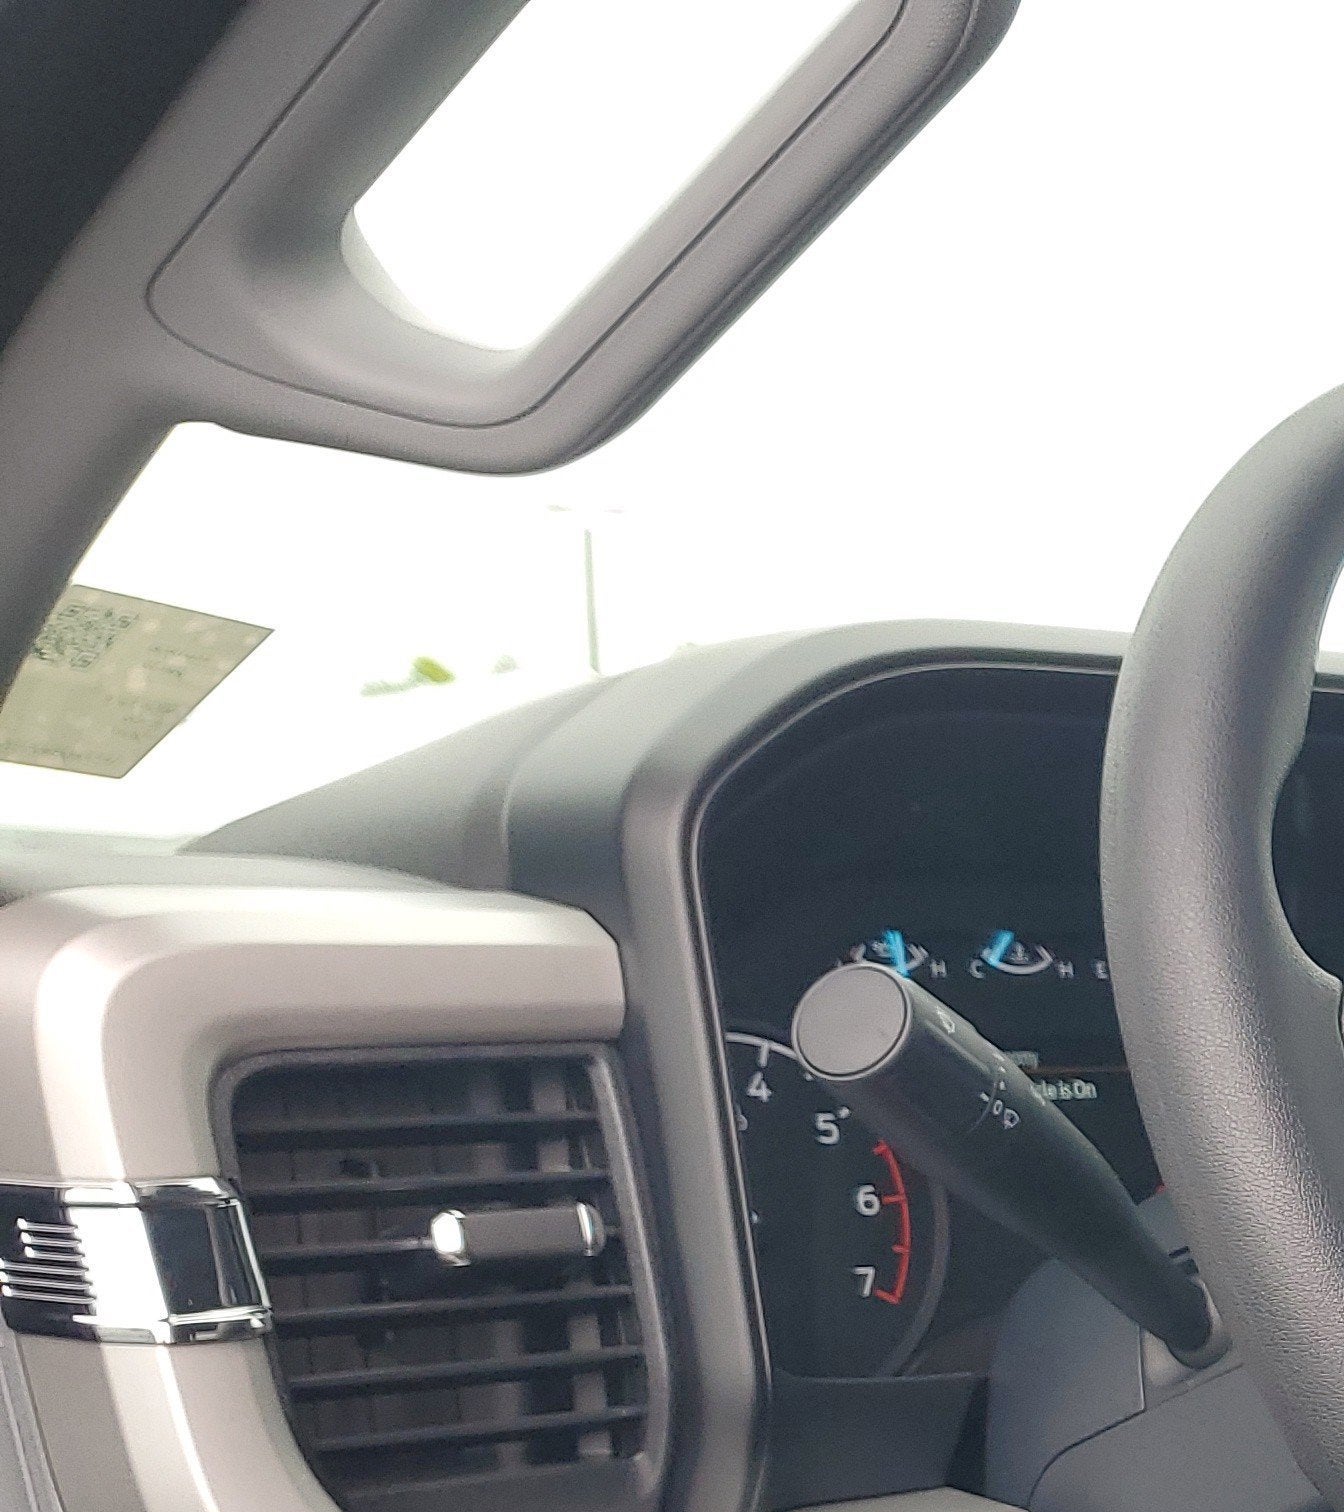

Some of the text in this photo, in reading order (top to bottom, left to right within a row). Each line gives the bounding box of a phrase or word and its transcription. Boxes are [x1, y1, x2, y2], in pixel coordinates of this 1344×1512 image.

[746, 1070, 773, 1103] 4
[814, 1111, 841, 1145] 5
[855, 1183, 882, 1217] 6
[852, 1265, 877, 1299] 7
